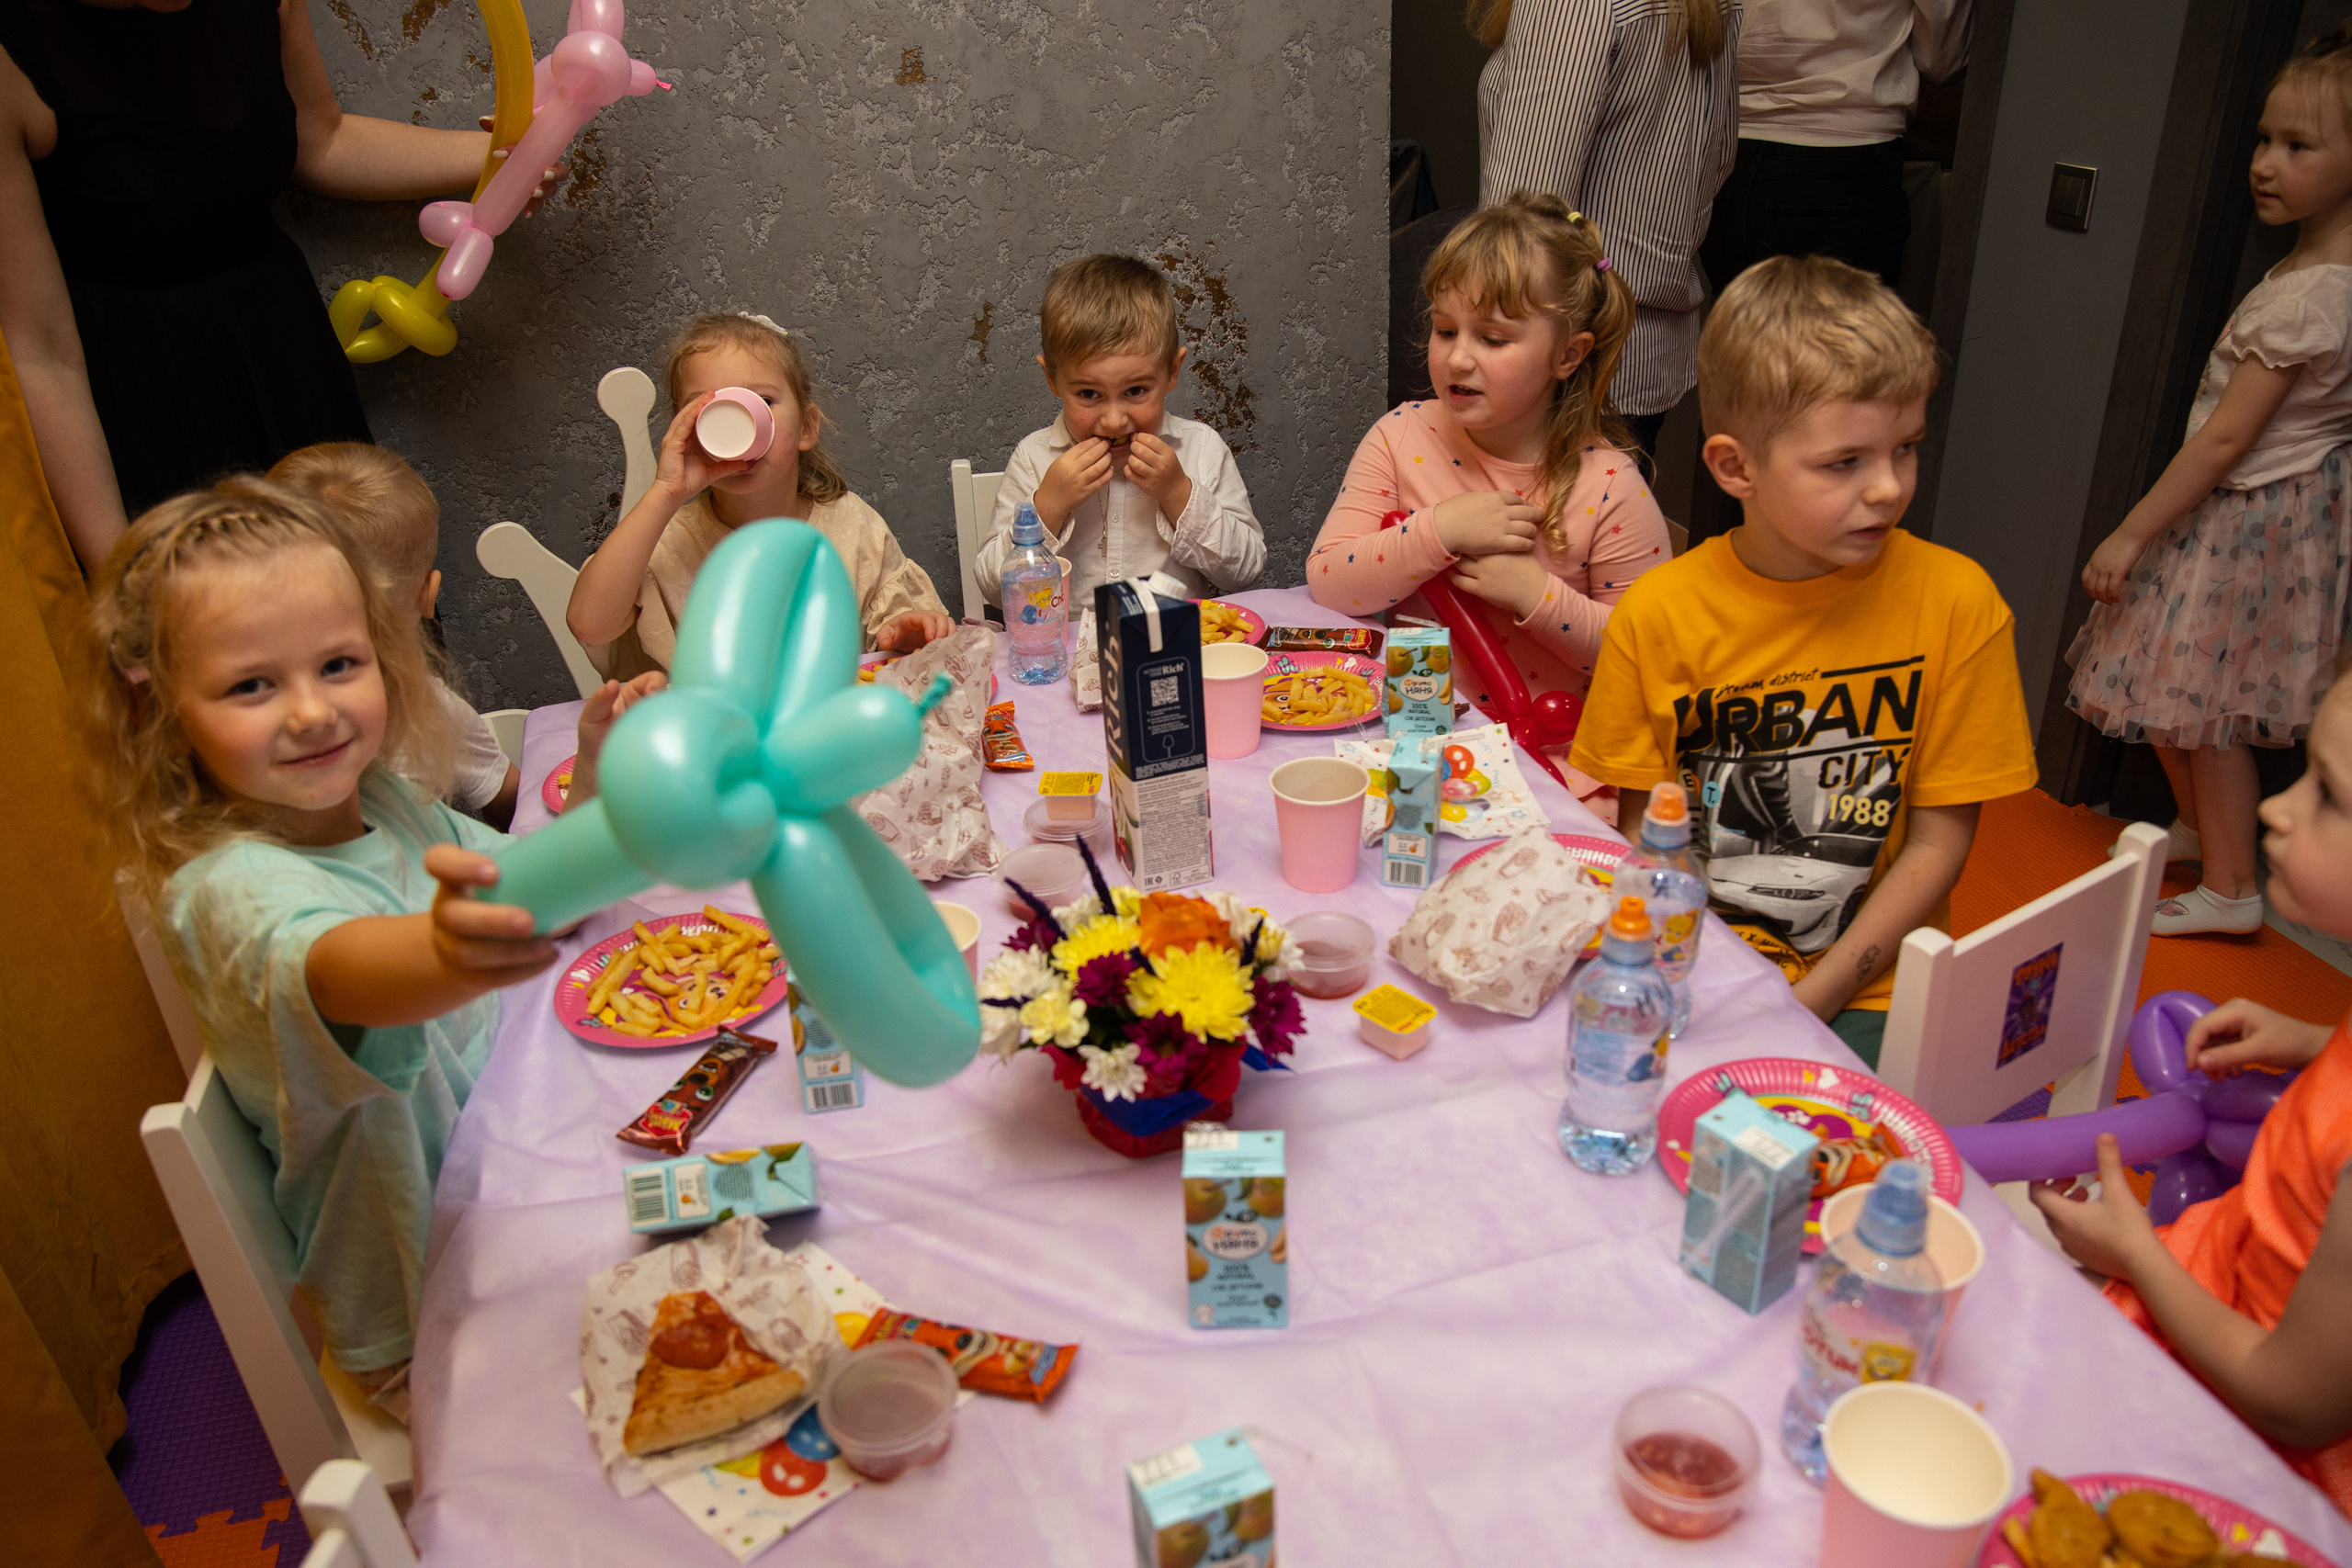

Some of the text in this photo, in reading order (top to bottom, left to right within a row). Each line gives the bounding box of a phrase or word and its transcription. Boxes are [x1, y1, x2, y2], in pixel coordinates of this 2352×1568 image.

[1673, 670, 1923, 755] URBAN
[1818, 747, 1911, 789] CITY
[1828, 793, 1891, 827] 1988
